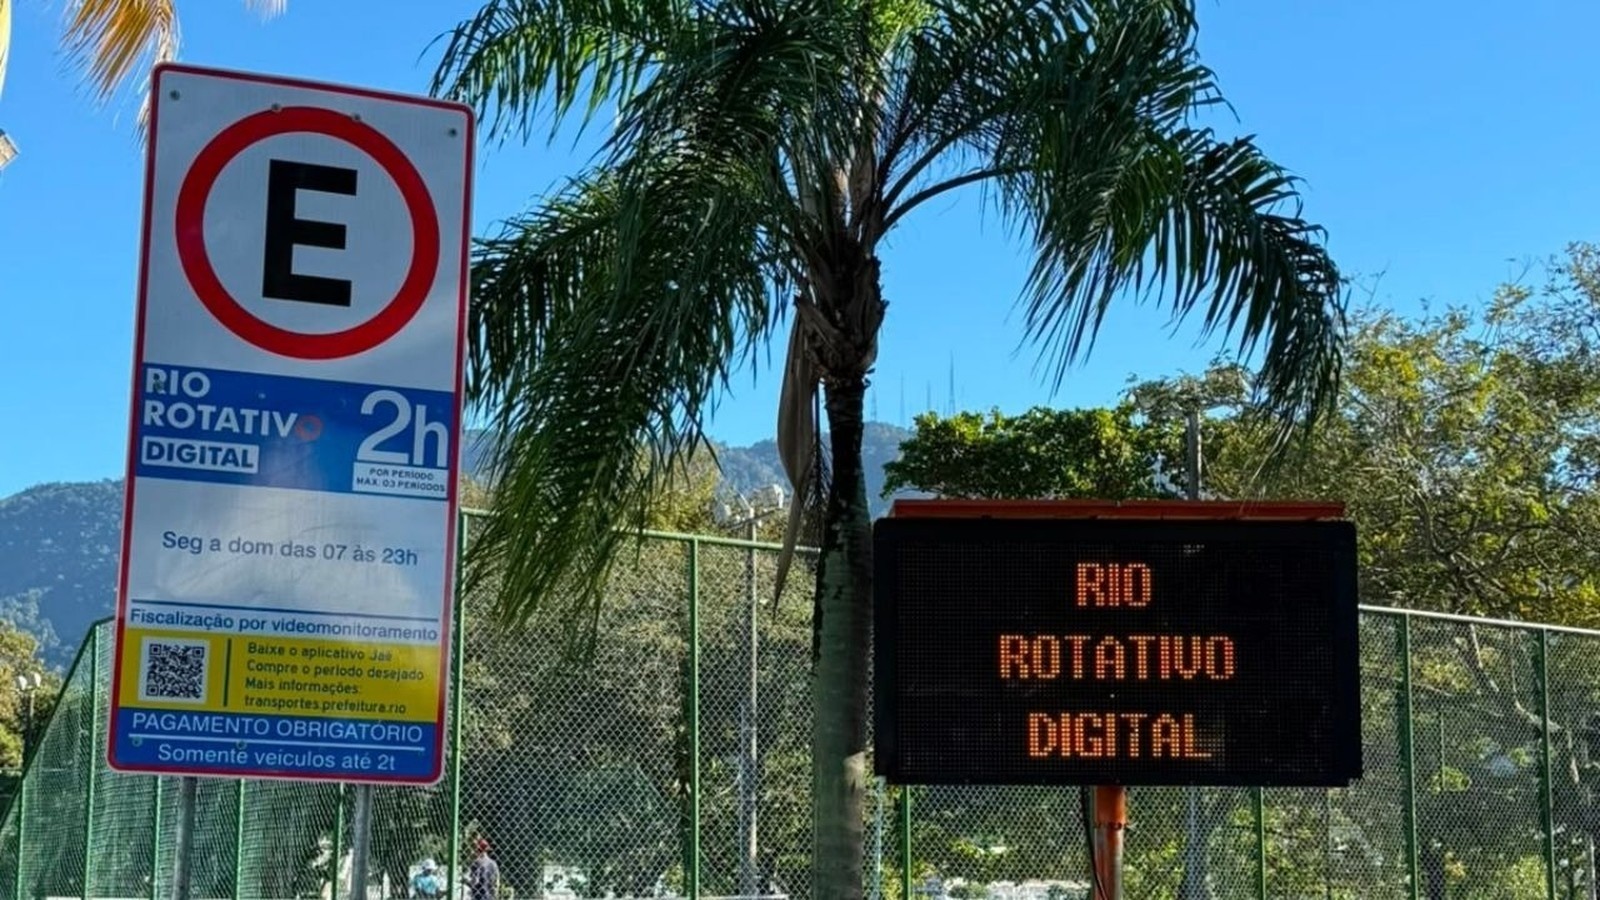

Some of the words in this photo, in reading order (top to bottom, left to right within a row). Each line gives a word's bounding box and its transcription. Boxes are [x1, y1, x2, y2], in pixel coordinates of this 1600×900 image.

[262, 159, 358, 307] E
[146, 367, 211, 398] RIO
[143, 400, 323, 441] ROTATIVO
[356, 390, 449, 468] 2h
[144, 440, 254, 469] DIGITAL
[369, 468, 389, 476] POR
[382, 480, 396, 488] 03
[162, 531, 203, 555] Seg
[209, 537, 222, 552] a
[228, 536, 273, 557] dom
[280, 539, 317, 559] das
[323, 544, 346, 560] 07
[353, 546, 376, 563] às
[381, 548, 419, 567] 23h
[1077, 563, 1152, 607] RIO
[130, 609, 234, 632] Fiscalização
[238, 618, 267, 633] por
[272, 616, 438, 642] videomonitoramento
[247, 642, 285, 657] Baixe
[289, 647, 298, 656] o
[302, 645, 366, 661] aplicativo
[999, 634, 1236, 680] ROTATIVO
[245, 677, 275, 691] Mais
[247, 659, 298, 674] Compre
[302, 664, 310, 675] o
[367, 667, 425, 682] desejado
[245, 695, 407, 714] transportes.prefeitura.rio
[132, 713, 270, 736] PAGAMENTO
[276, 719, 423, 743] OBRIGATÓRIO
[1028, 713, 1212, 758] DIGITAL
[158, 744, 248, 764] Somente
[254, 748, 336, 768] veículos
[342, 750, 372, 770] até
[377, 753, 396, 771] 2t
